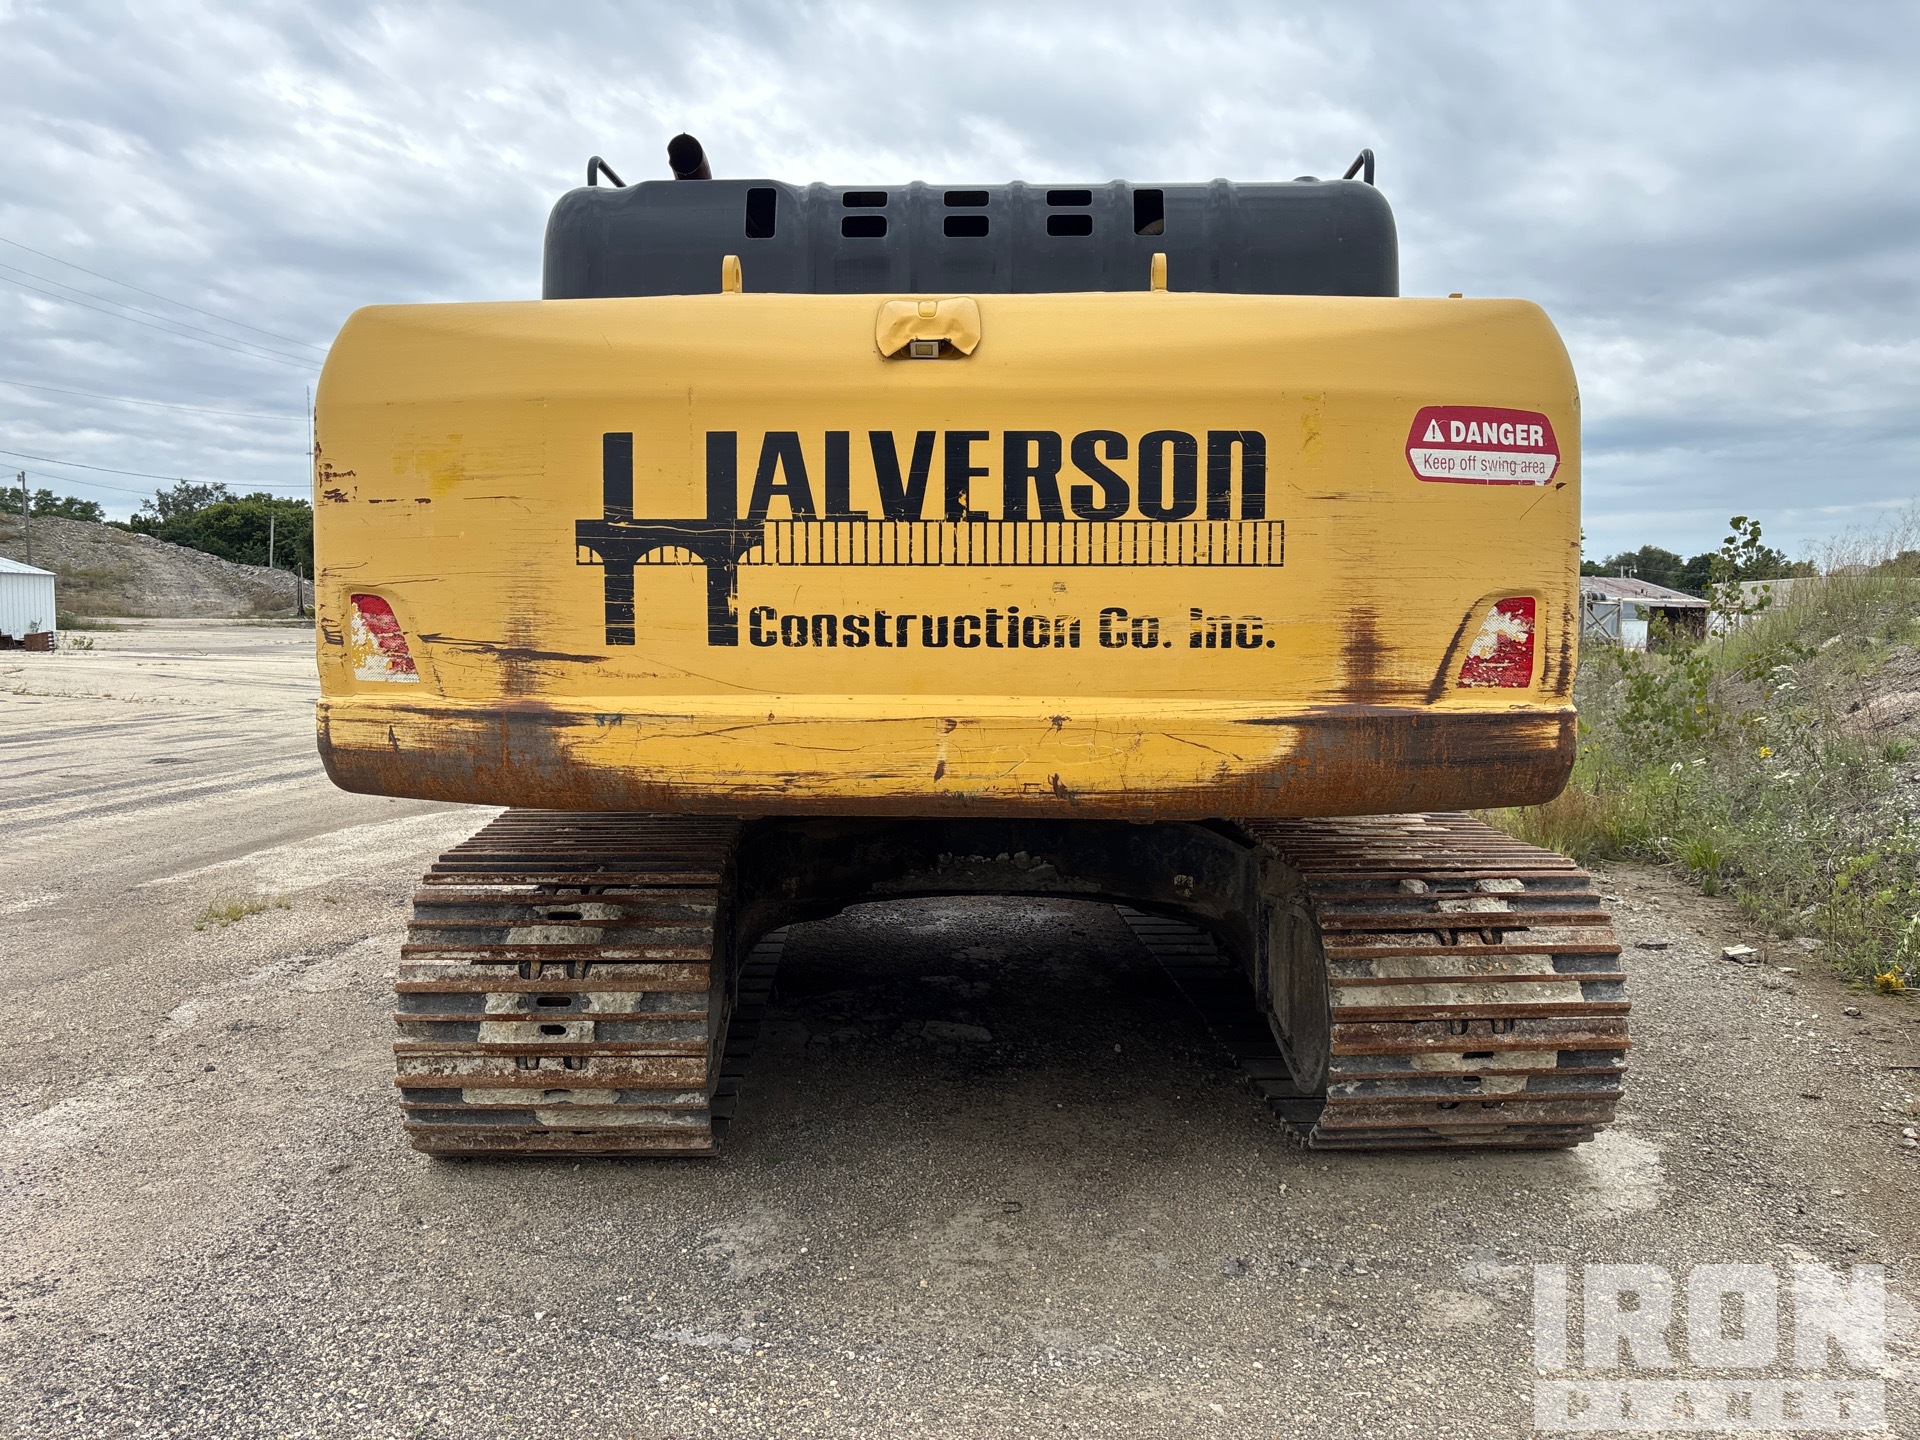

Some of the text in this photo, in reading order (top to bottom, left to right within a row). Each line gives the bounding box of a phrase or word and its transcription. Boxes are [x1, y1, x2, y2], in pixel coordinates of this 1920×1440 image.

[1450, 420, 1544, 446] DANGER
[1424, 453, 1546, 476] Keep off swing area
[748, 605, 1277, 649] Construction Co. Inc.
